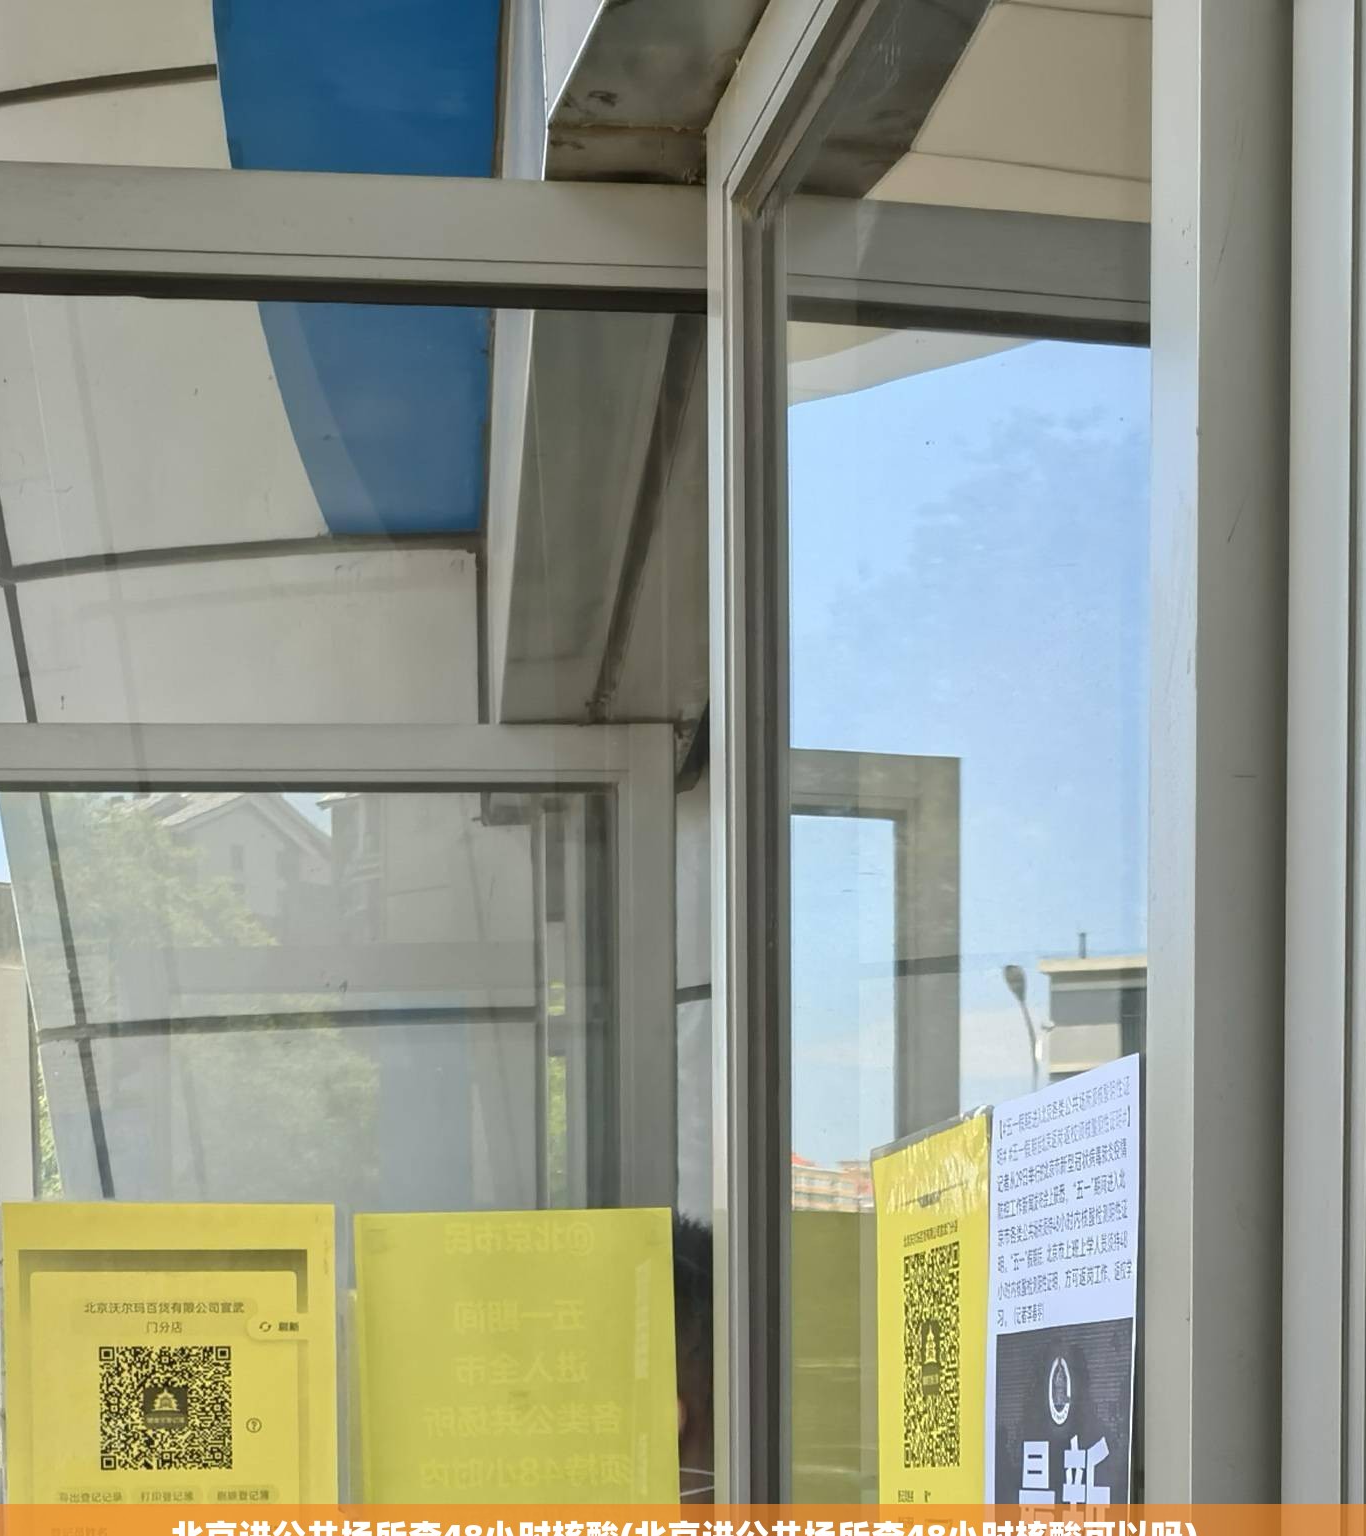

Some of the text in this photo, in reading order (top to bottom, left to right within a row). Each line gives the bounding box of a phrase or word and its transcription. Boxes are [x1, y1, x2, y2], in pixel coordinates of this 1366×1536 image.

[84, 1302, 245, 1314] 北京沃尔玛百货有限公司宣武
[146, 1321, 183, 1333] 门分店
